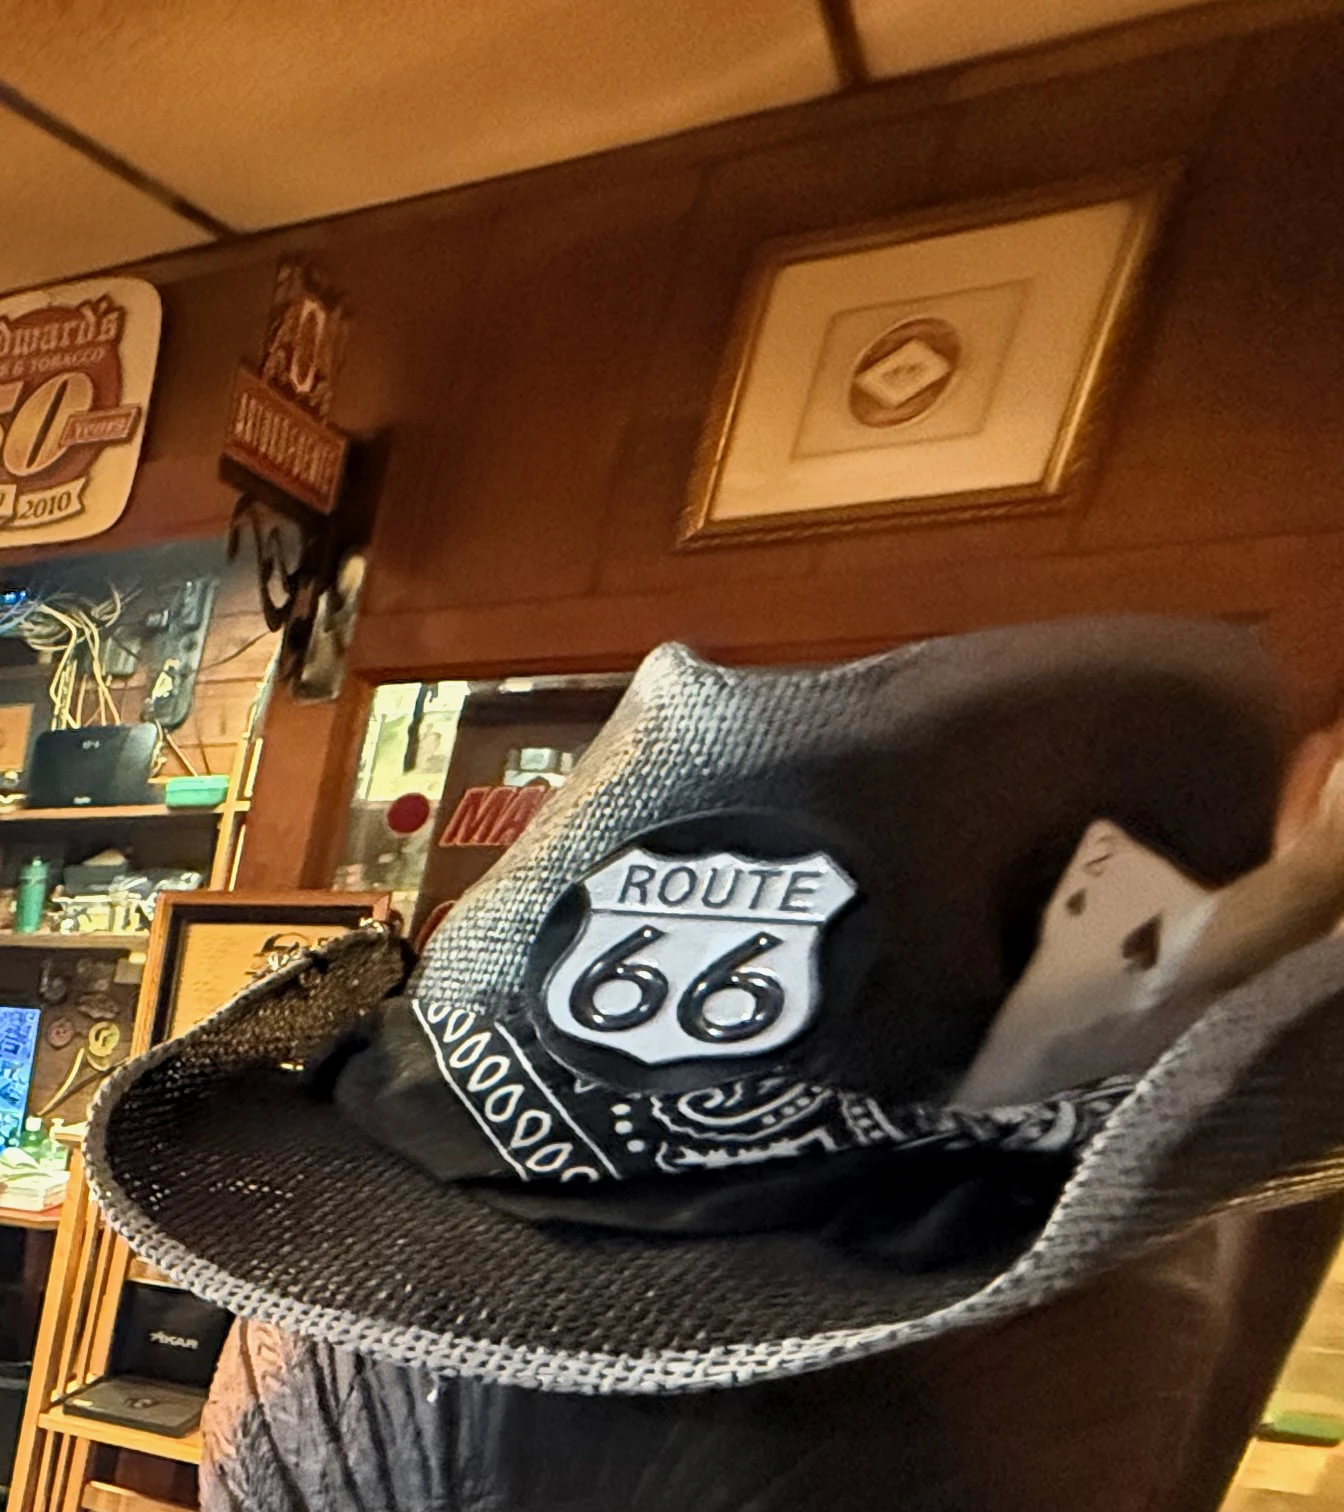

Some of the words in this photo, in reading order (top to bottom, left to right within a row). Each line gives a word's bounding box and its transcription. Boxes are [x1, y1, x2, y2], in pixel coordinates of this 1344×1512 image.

[20, 492, 72, 519] 2010
[617, 864, 822, 912] ROUTE
[569, 924, 785, 1044] 66
